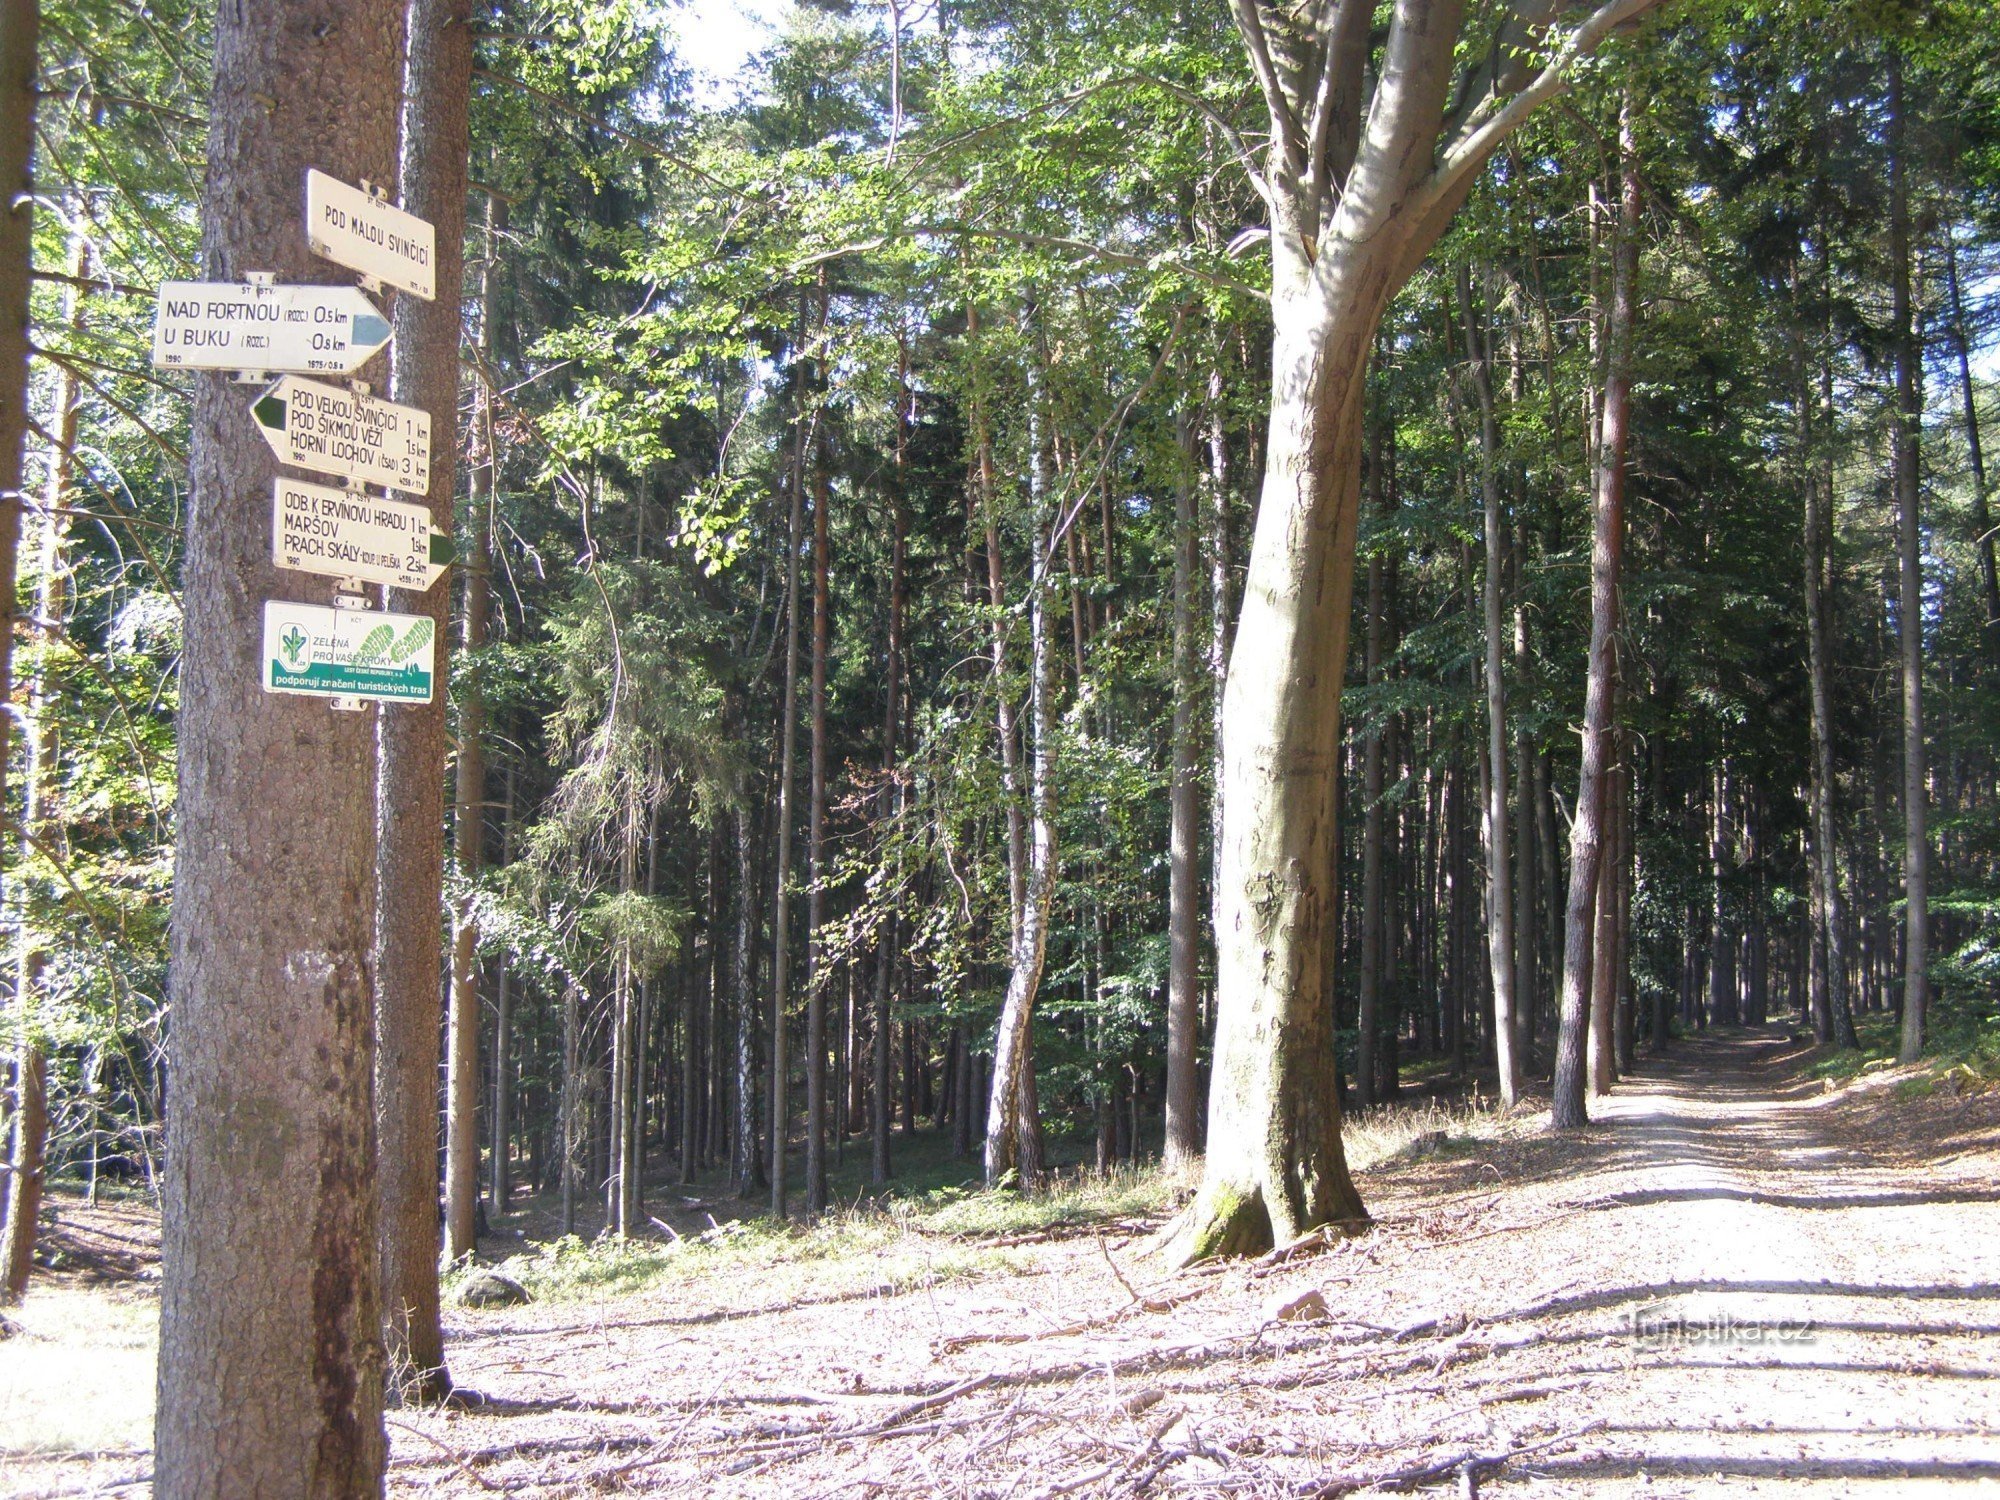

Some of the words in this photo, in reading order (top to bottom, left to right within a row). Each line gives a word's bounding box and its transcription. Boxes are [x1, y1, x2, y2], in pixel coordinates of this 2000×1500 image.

[325, 204, 346, 229] POD
[351, 216, 384, 246] MALOU
[388, 234, 429, 267] SVINČICÍ
[166, 301, 201, 318] NAD
[207, 302, 280, 321] FORTNOU
[164, 328, 176, 345] U
[183, 329, 230, 347] BUKU
[165, 354, 182, 363] 1990
[292, 389, 313, 410] POD
[316, 396, 352, 419] VELKOU
[354, 406, 398, 431] SVINČICÍ
[407, 420, 411, 436] 1
[417, 423, 428, 440] km
[291, 409, 313, 431] POD
[317, 413, 358, 441] ŠIKMOU
[361, 426, 383, 448] VĚŽÍ
[290, 430, 326, 454] HORNÍ
[332, 440, 375, 465] LOCHOV
[402, 458, 411, 474] 3
[416, 461, 427, 478] km
[292, 451, 306, 462] 1990
[285, 491, 310, 513] ODB.
[312, 497, 318, 514] K
[321, 498, 371, 524] ERVÍNOVU
[374, 510, 407, 531] HRADU
[411, 517, 415, 533] 1
[418, 519, 427, 535] km
[284, 513, 339, 539] MARŠOV
[284, 534, 325, 558] PRACH.
[286, 555, 300, 566] 1990
[313, 637, 350, 648] ZELENÁ
[312, 651, 333, 661] PRO
[335, 651, 360, 663] VAŠE
[361, 656, 393, 667] KROKY
[275, 674, 320, 689] podporují
[321, 677, 356, 689] značení
[358, 681, 409, 695] turistických
[410, 685, 428, 695] tras
